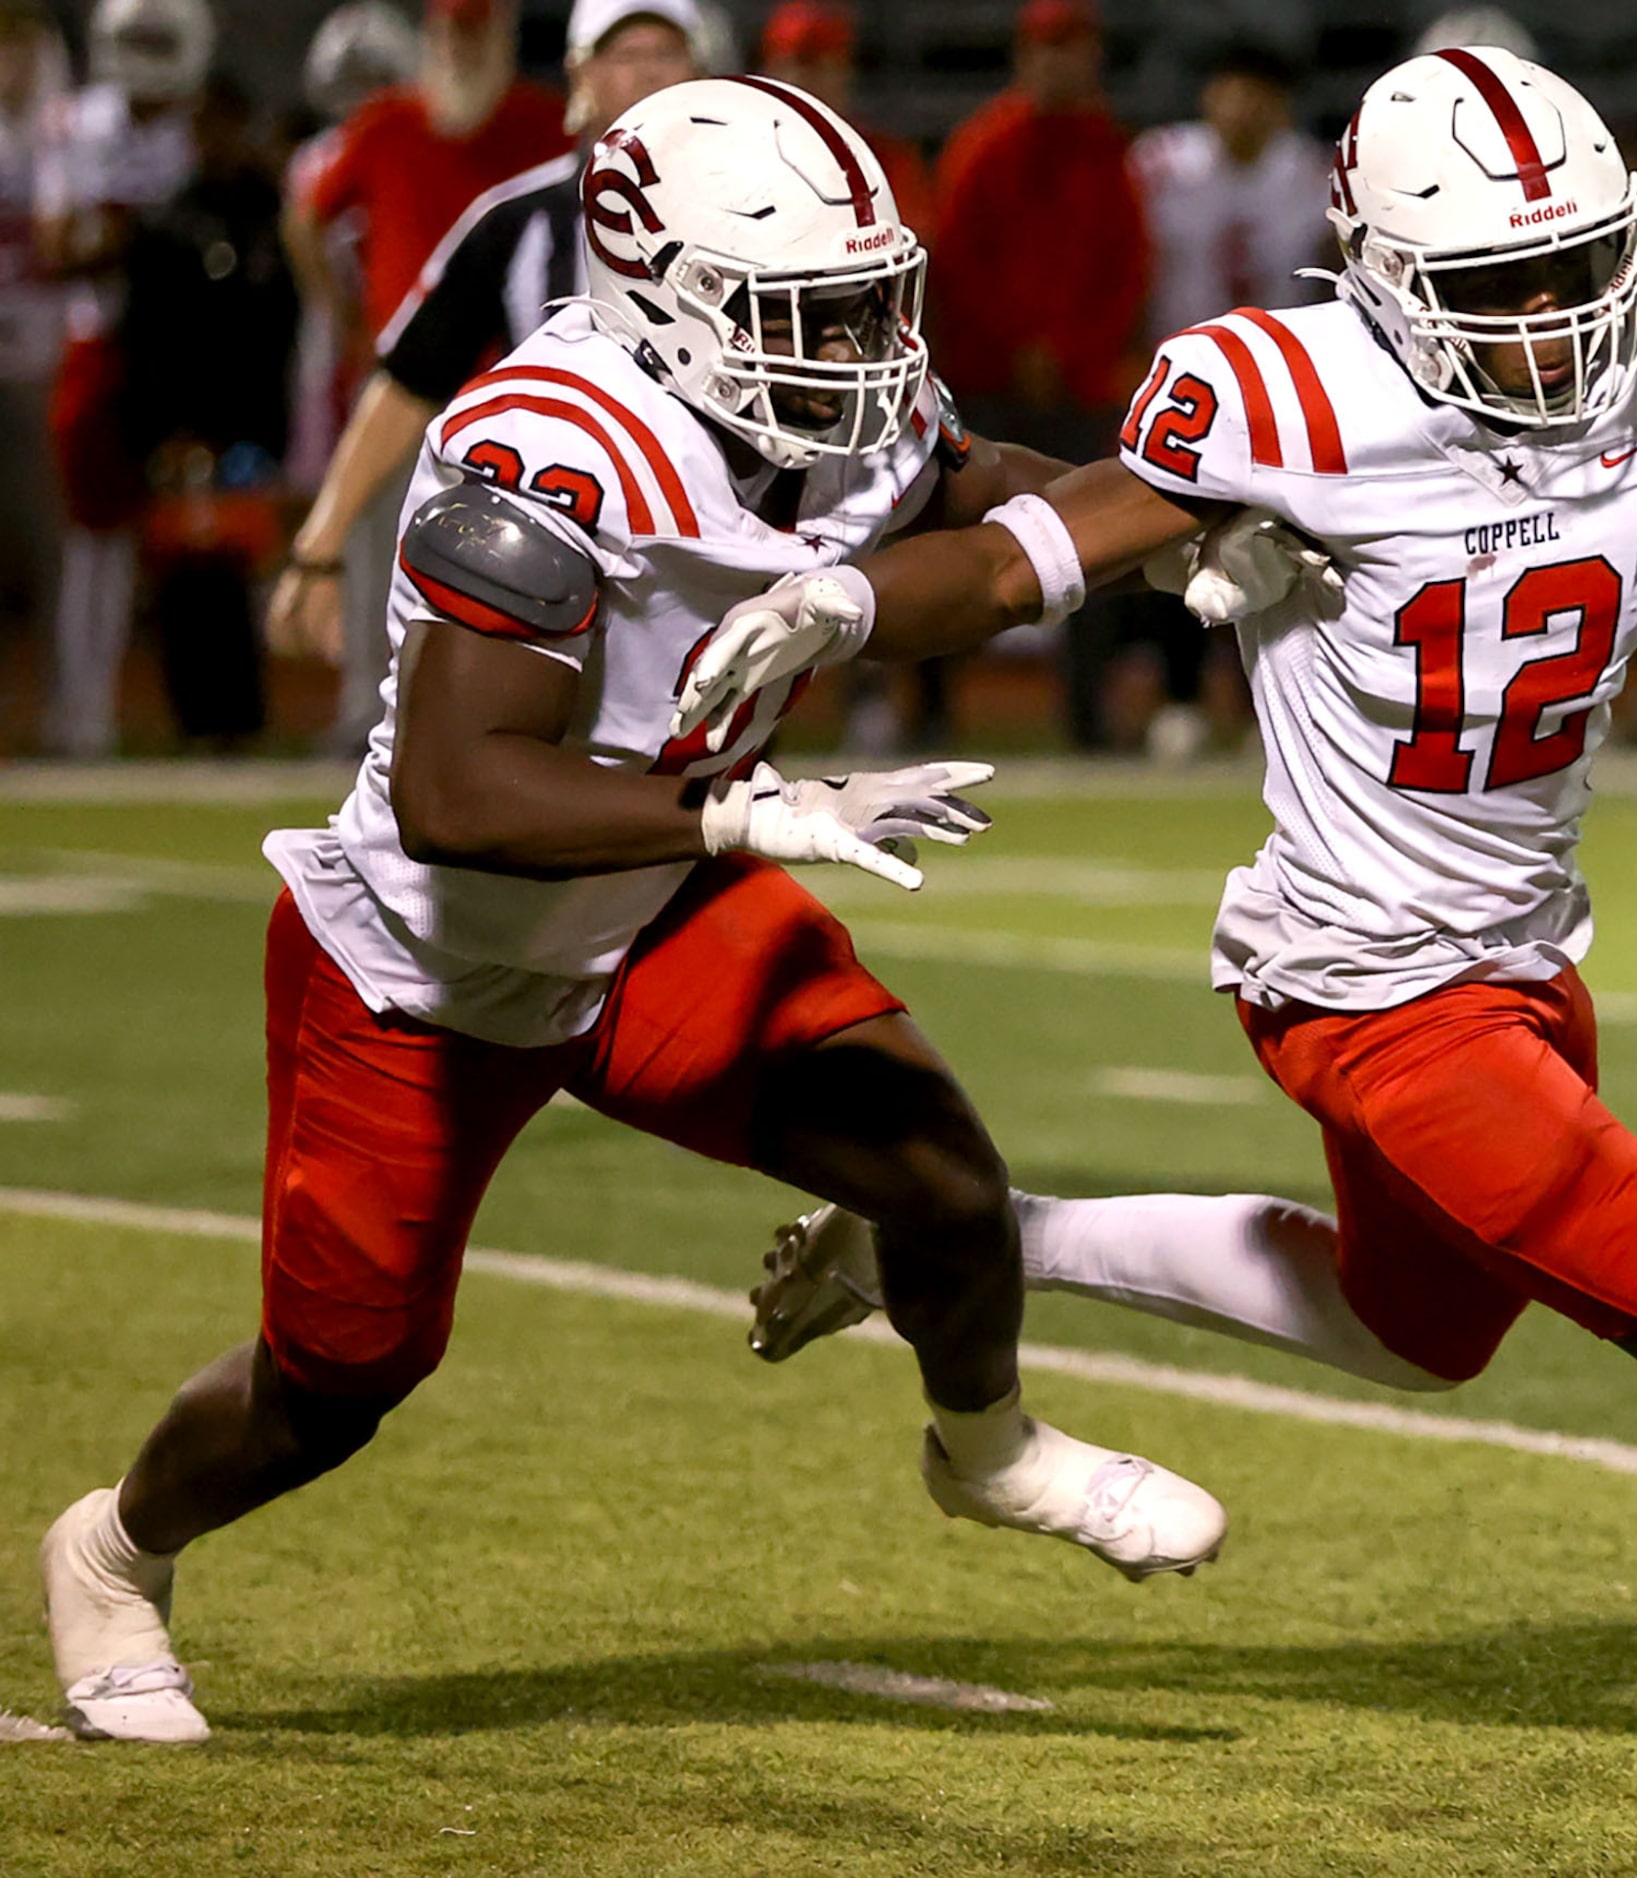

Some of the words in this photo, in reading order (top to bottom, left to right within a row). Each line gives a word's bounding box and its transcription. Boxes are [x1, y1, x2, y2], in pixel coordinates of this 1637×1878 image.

[1508, 196, 1579, 229] Riddell
[845, 226, 895, 254] Riddell
[1119, 354, 1220, 484] 12
[1464, 511, 1561, 556] COPPELL
[1387, 554, 1623, 793] 12
